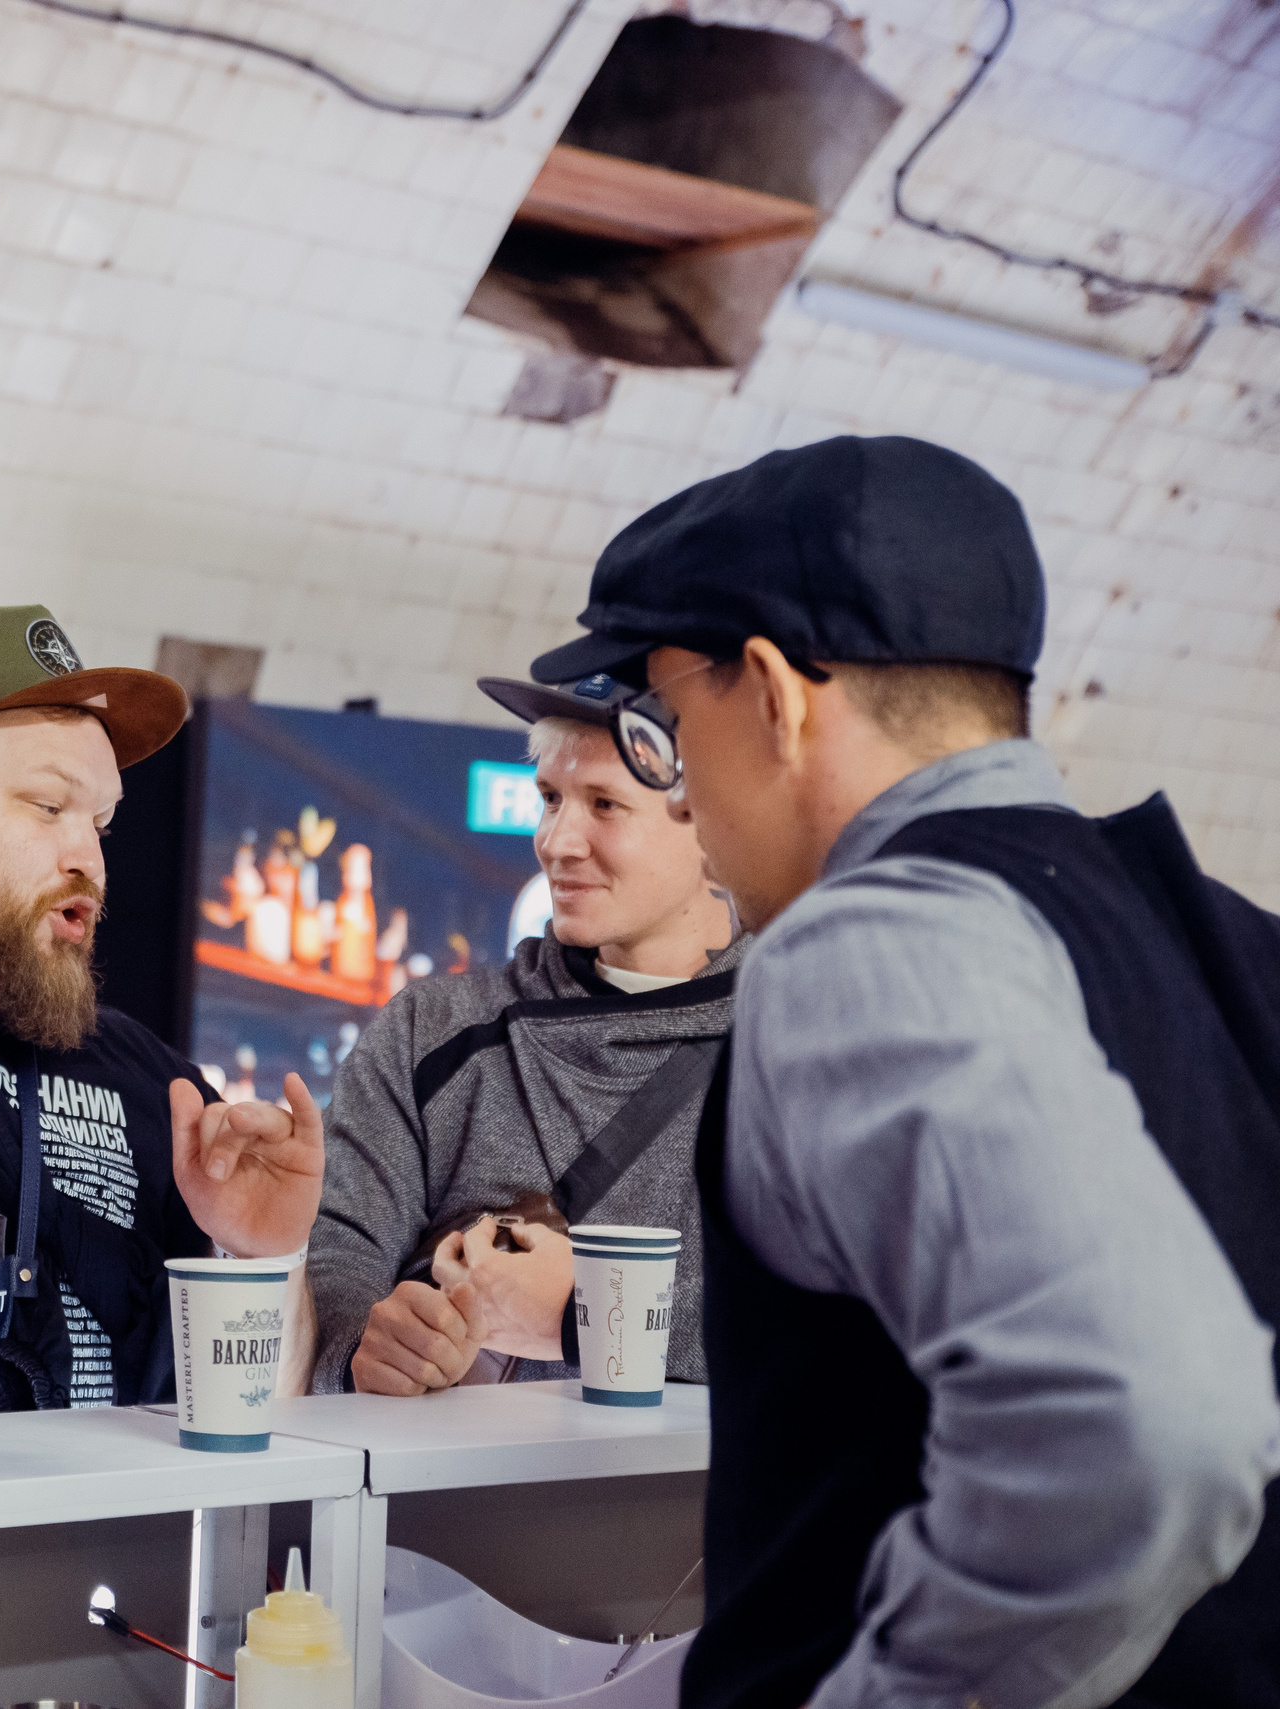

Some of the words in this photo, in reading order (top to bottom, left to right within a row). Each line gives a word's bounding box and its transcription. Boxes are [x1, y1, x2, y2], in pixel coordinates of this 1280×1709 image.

[52, 1144, 58, 1155] И
[58, 1145, 64, 1156] Я
[72, 1182, 99, 1198] МАЛОЕ,
[181, 1288, 190, 1349] CRAFTED
[245, 1367, 272, 1381] GIN
[182, 1353, 194, 1424] MASTERLY
